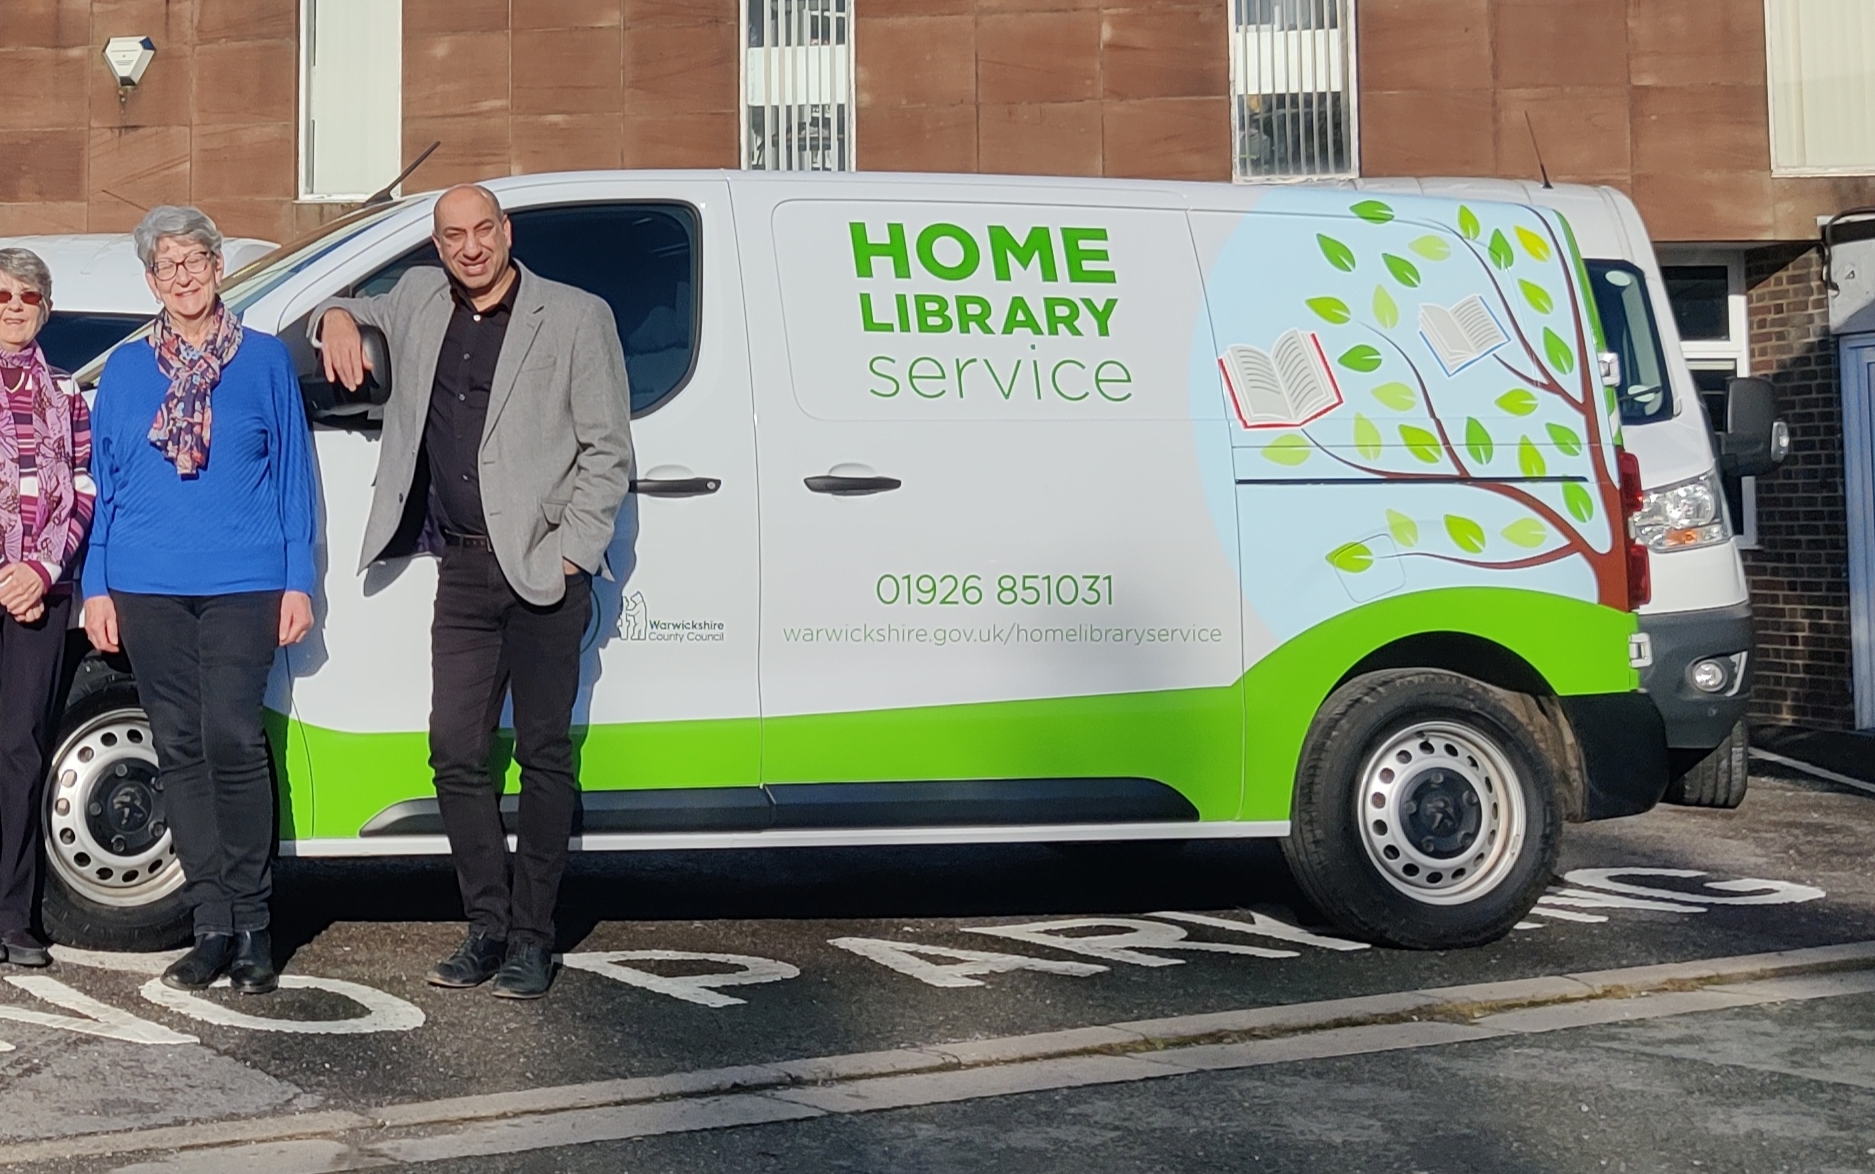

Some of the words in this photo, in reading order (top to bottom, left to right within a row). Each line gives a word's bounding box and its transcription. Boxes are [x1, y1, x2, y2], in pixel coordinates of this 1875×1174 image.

[849, 221, 1116, 284] HOME
[860, 293, 1116, 337] LIBRARY
[869, 343, 1133, 402] service
[876, 574, 983, 606] 01926
[997, 574, 1112, 606] 851031
[648, 632, 684, 643] County
[687, 632, 724, 641] Council
[649, 619, 724, 630] Warwickshire
[782, 622, 1223, 648] warwickshire.gov.uk/homelibraryservice
